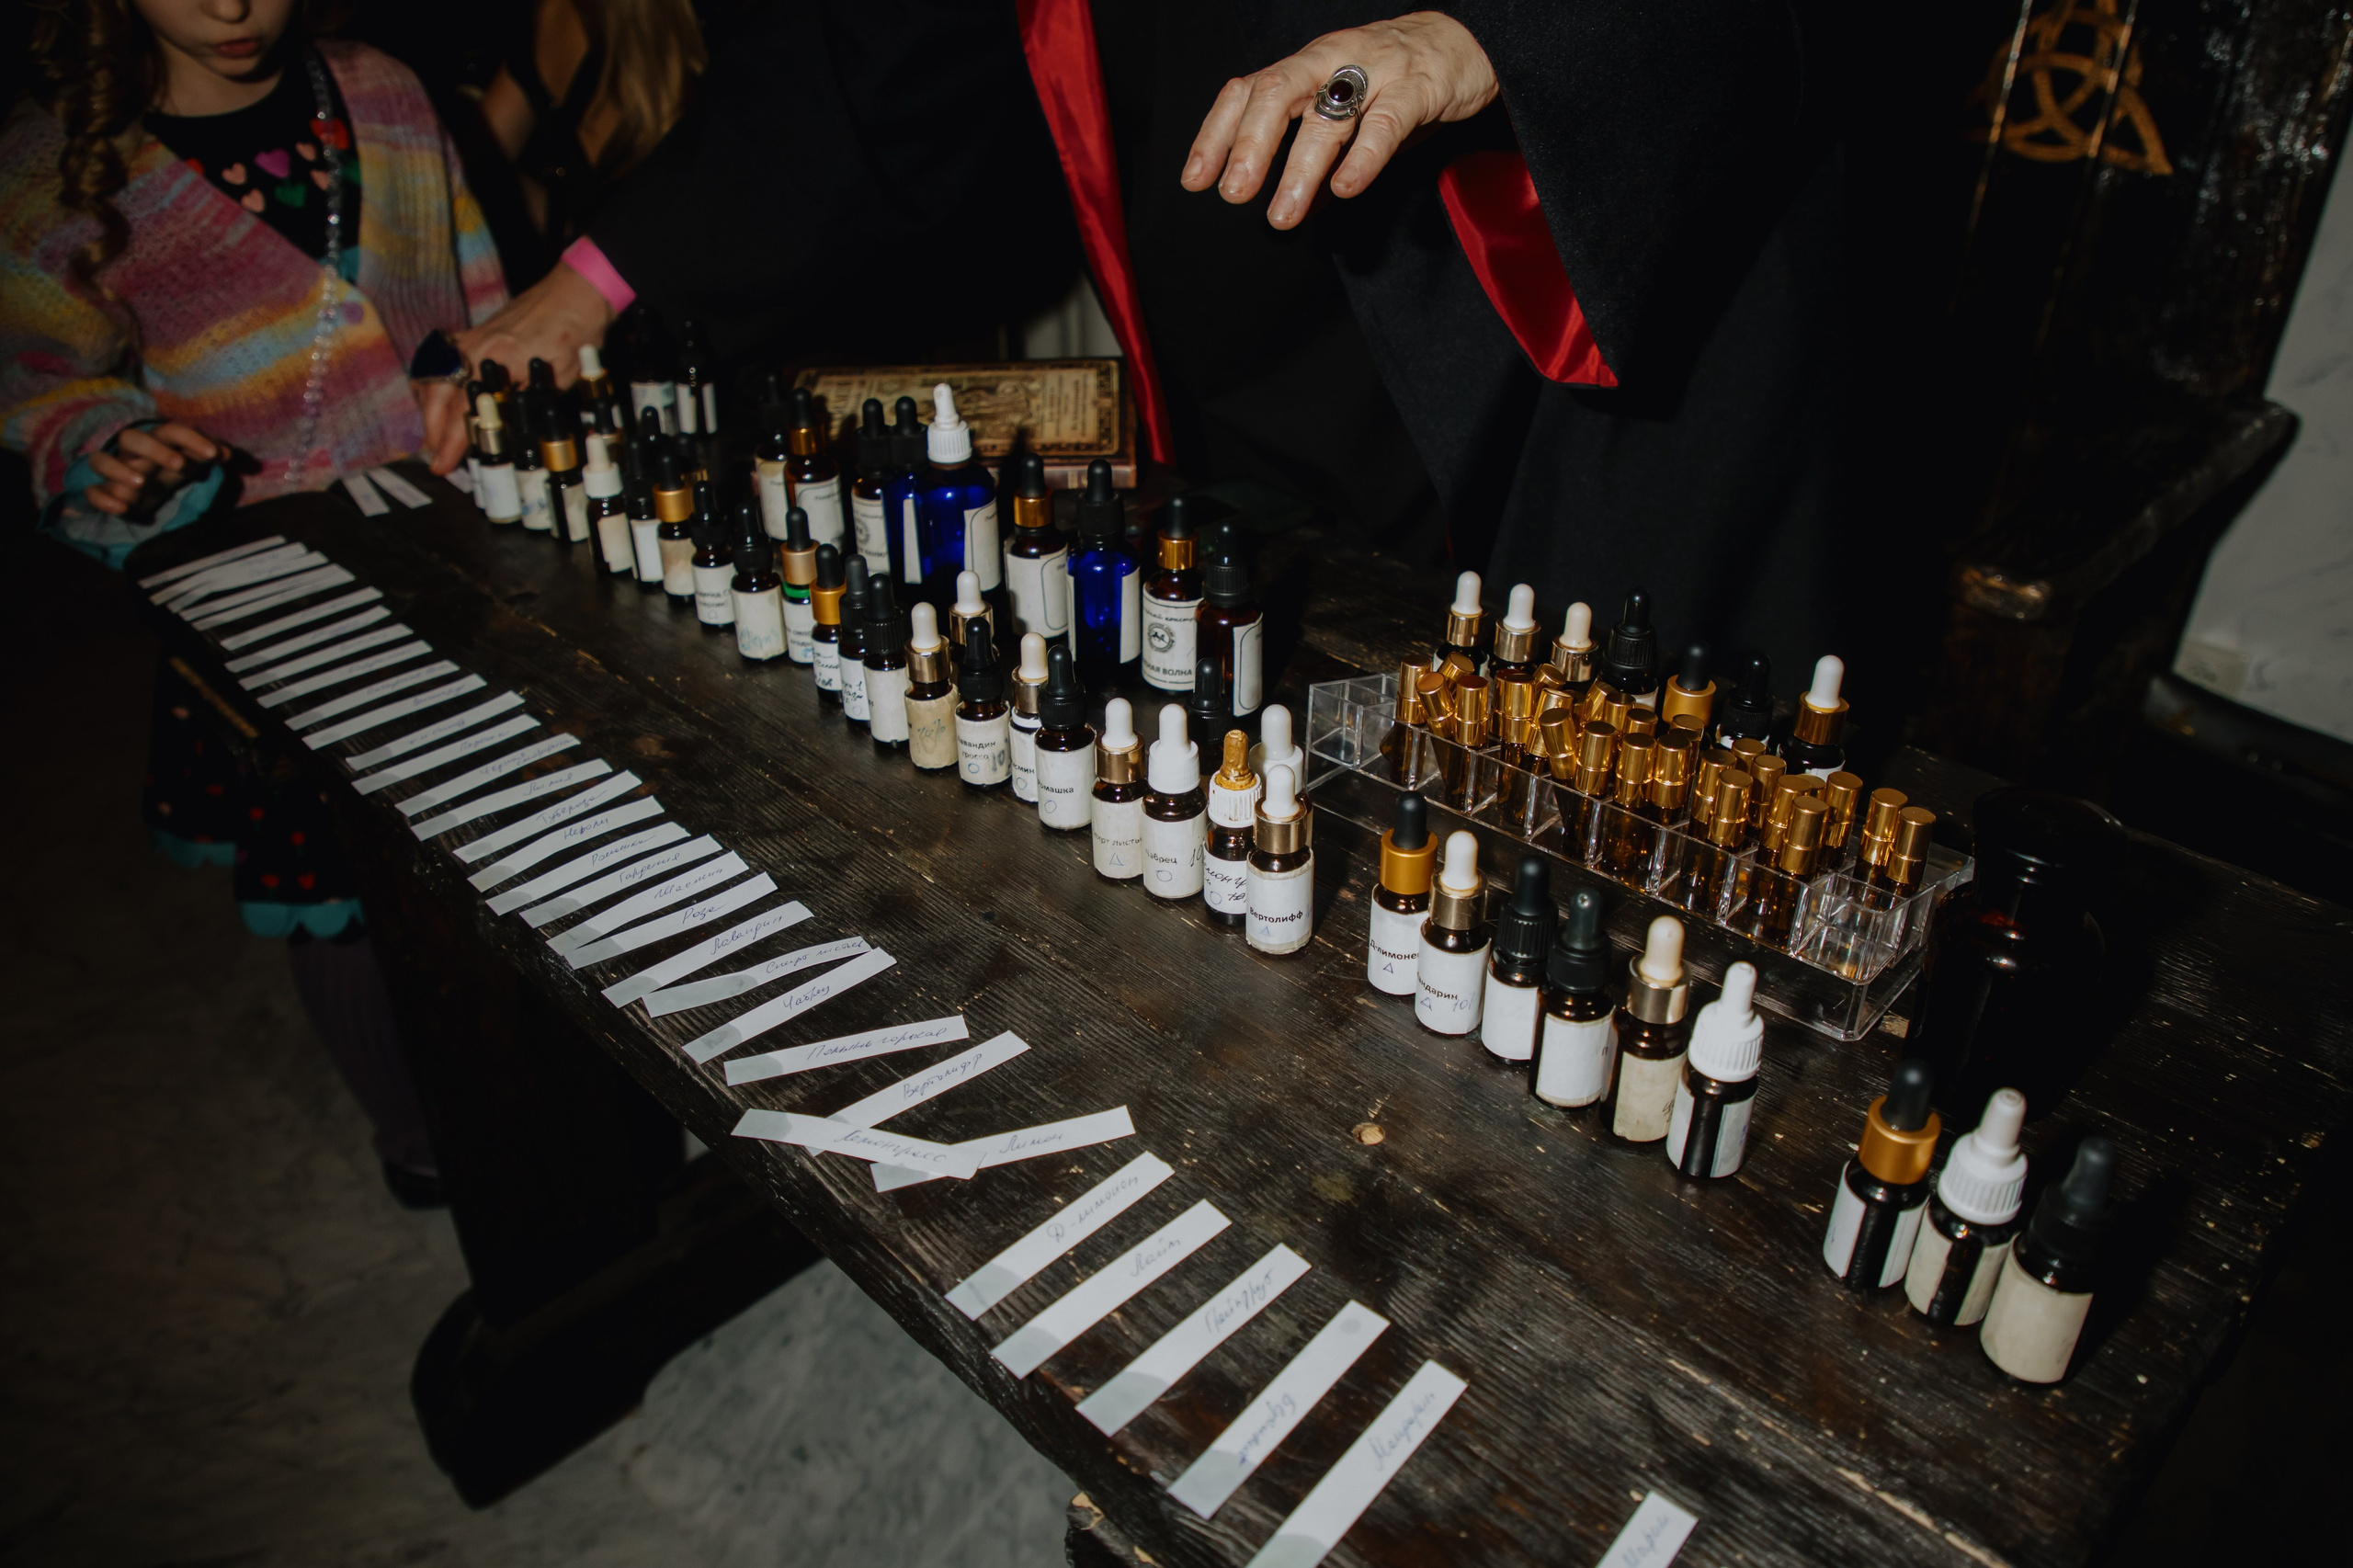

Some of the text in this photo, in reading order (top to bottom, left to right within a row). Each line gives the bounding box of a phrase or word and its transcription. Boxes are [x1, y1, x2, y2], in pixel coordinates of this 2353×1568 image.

[1163, 668, 1192, 676] ВОЛНА
[1038, 779, 1074, 794] Ромашка
[564, 817, 608, 840] Нероли
[591, 835, 655, 867] Ромашка
[682, 903, 726, 925] Роза
[1249, 906, 1303, 924] Вертолифф
[710, 915, 783, 956] Лавандин
[783, 983, 831, 1011] Чабрец
[807, 1027, 948, 1061] Полынь горькая
[999, 1131, 1063, 1154] Лимон
[1130, 1239, 1182, 1278] Лайм
